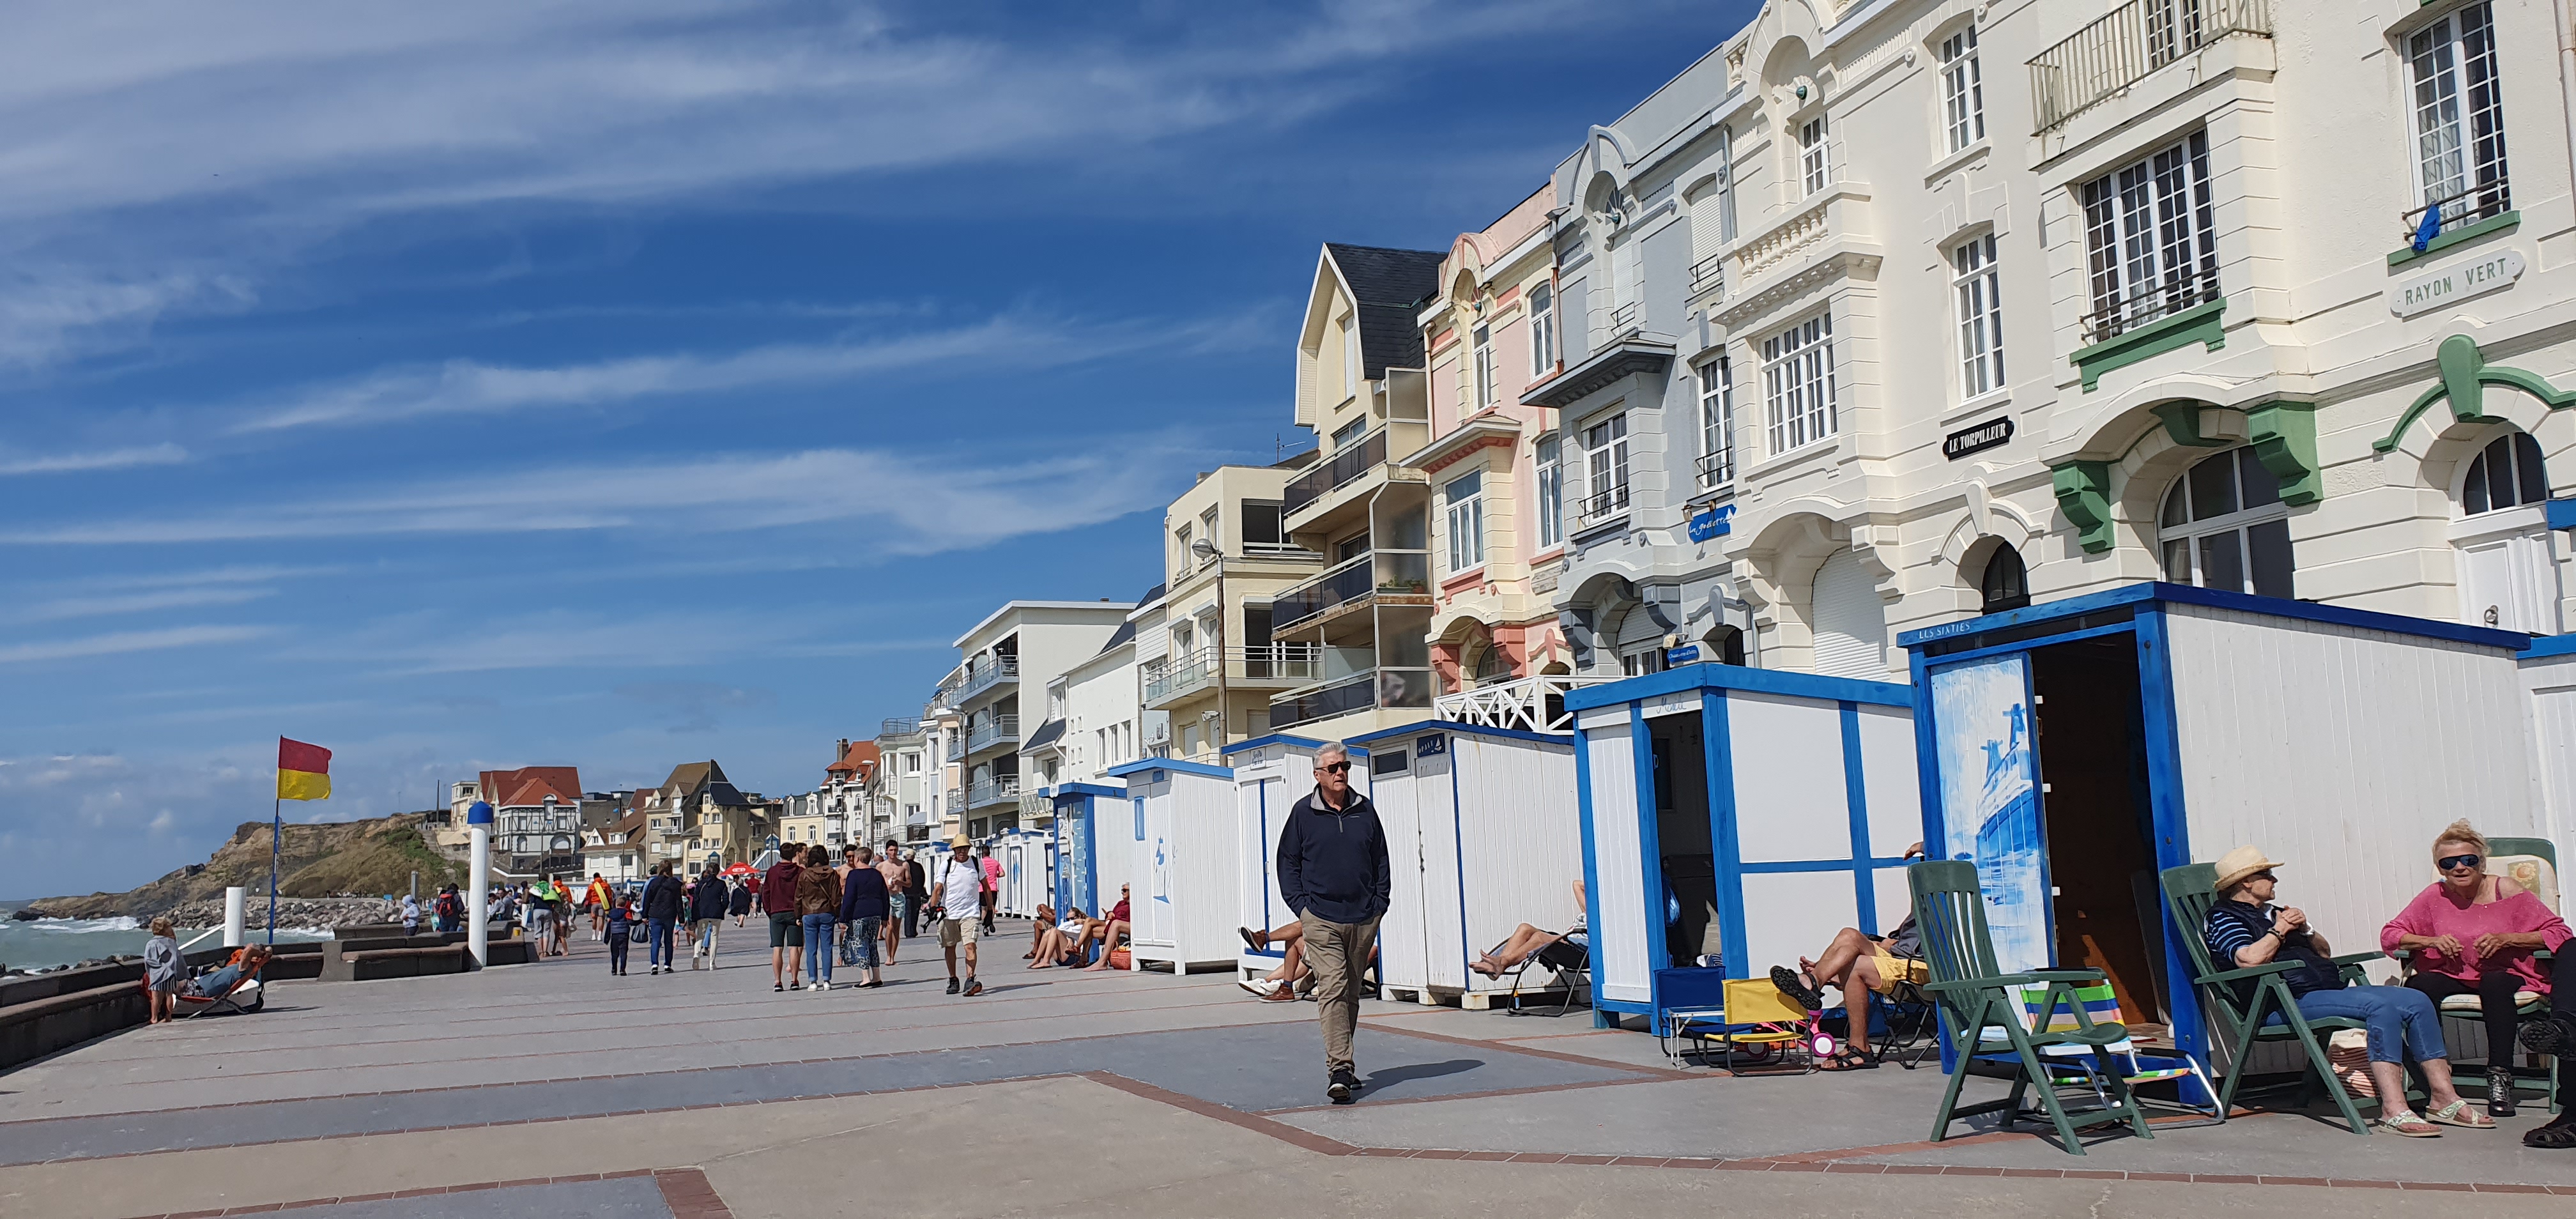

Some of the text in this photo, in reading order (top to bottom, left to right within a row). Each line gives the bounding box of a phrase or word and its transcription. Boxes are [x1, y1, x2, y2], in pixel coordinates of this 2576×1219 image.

[2405, 257, 2507, 306] RAYON VERT
[1949, 422, 2006, 454] LE TORPILLEUR
[1936, 622, 1970, 636] SIXTIES
